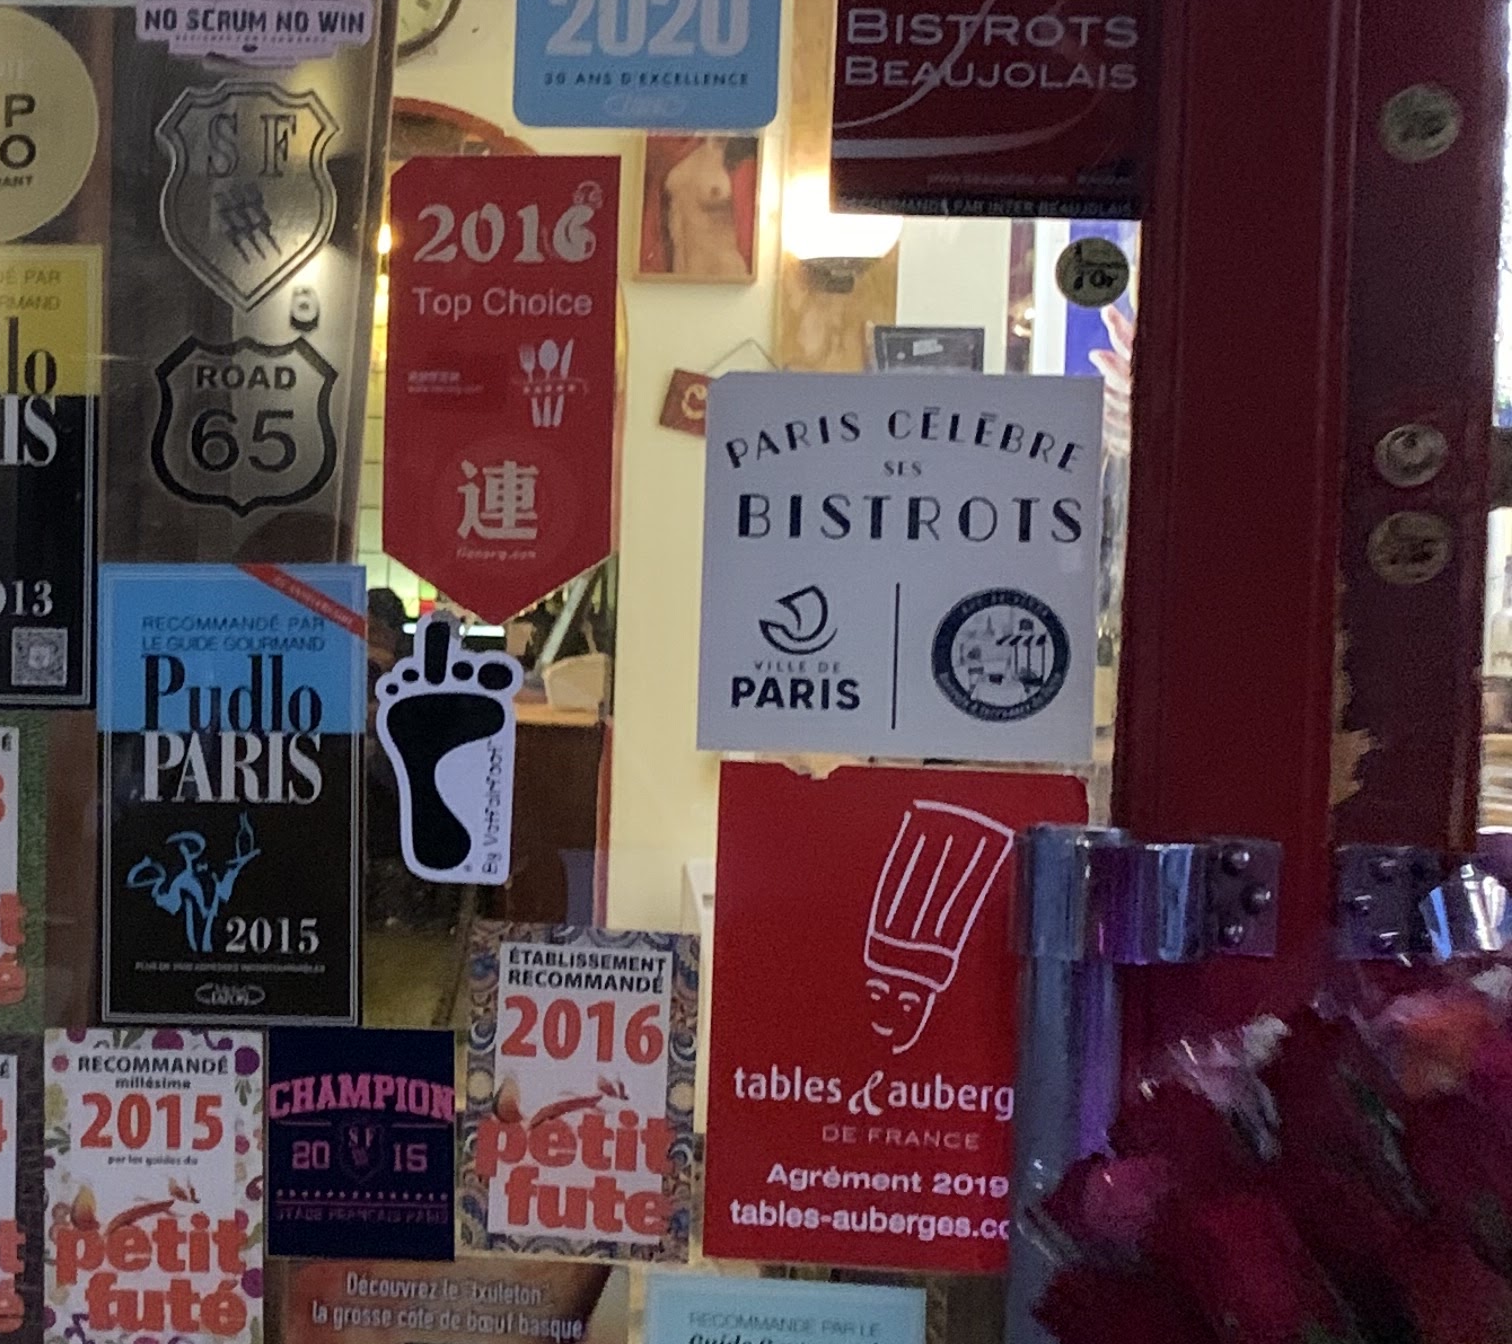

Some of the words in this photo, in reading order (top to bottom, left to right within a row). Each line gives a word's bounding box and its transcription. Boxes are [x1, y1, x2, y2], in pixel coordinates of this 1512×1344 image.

[145, 8, 178, 30] NO
[187, 9, 267, 33] SCRUM
[276, 10, 309, 32] NO
[319, 11, 365, 34] WIN
[847, 8, 1138, 49] BISTROTS
[844, 56, 1138, 90] BEAUJOLAIS
[414, 201, 597, 264] 2016
[412, 287, 472, 321] Top
[483, 287, 593, 317] Choice
[195, 365, 298, 391] ROAD
[190, 408, 298, 474] 65
[883, 460, 923, 477] SES
[456, 459, 539, 541] 連
[737, 492, 1084, 544] BISTROTS
[141, 614, 280, 632] RECOMMANDÉ
[288, 616, 325, 631] PAR
[141, 636, 163, 651] LE
[167, 636, 218, 651] GUIDE
[223, 636, 325, 652] GOURMAND
[754, 659, 809, 674] VILLE
[818, 660, 842, 674] DE
[140, 653, 323, 733] Pudlo
[731, 675, 862, 711] PARIS
[139, 731, 323, 806] PARIS
[225, 916, 320, 955] 2015
[509, 946, 667, 974] ÉTABLISSEMENT
[508, 970, 664, 994] RECOMMANDÉ
[500, 994, 664, 1065] 2016
[78, 1054, 229, 1076] RECOMMANDÉ
[115, 1076, 192, 1091] millésime
[80, 1092, 225, 1151] 2015
[822, 1123, 857, 1143] DE
[868, 1127, 981, 1151] FRANCE
[292, 1140, 331, 1170] 20
[393, 1142, 428, 1172] 15
[474, 1109, 673, 1178] petit
[767, 1162, 923, 1194] Agrément
[54, 1211, 248, 1287] petit
[85, 1271, 248, 1336] futé
[312, 1299, 328, 1325] la
[333, 1306, 392, 1330] grosse
[440, 1309, 461, 1330] de
[518, 1314, 583, 1344] basque
